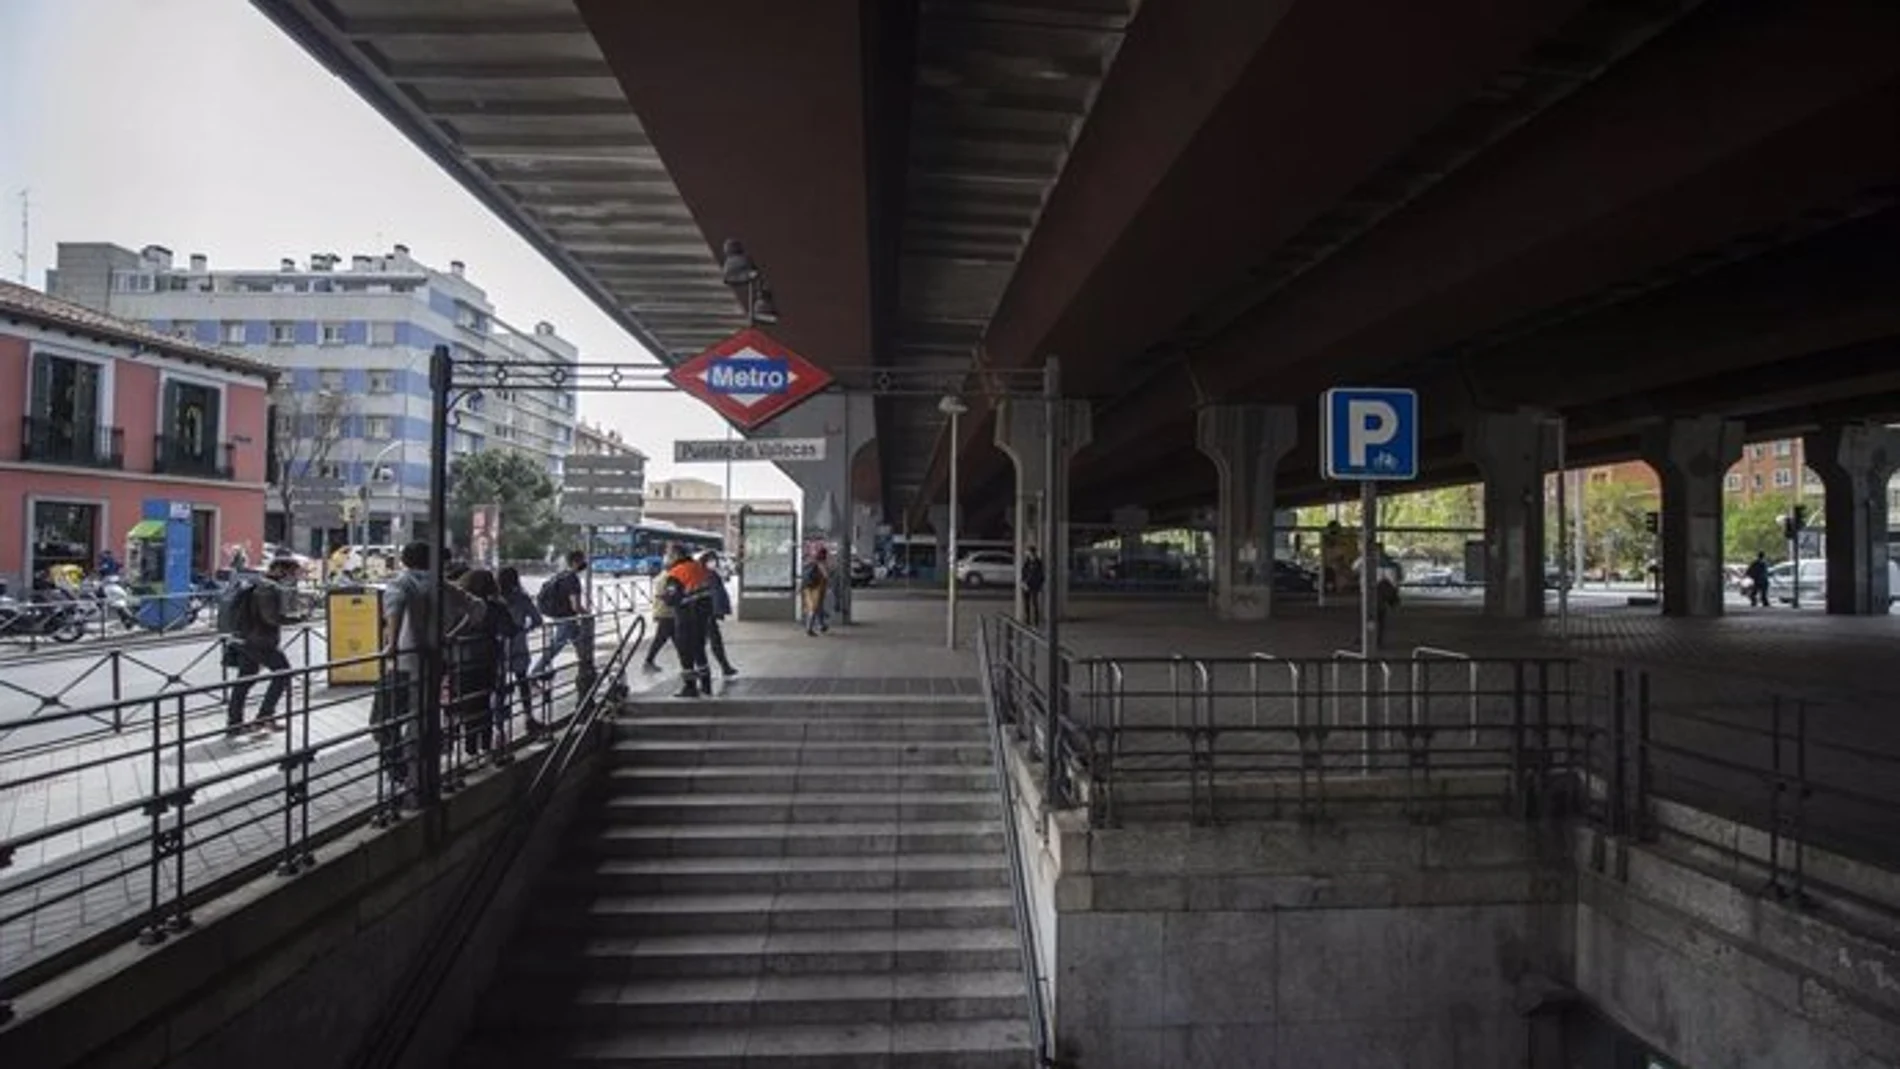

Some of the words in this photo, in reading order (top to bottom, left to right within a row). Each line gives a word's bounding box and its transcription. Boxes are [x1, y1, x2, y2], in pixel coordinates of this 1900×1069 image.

[712, 366, 784, 387] Metro
[1348, 400, 1398, 466] P
[682, 443, 731, 459] Puente
[735, 442, 755, 458] de
[758, 441, 816, 457] Vallecas
